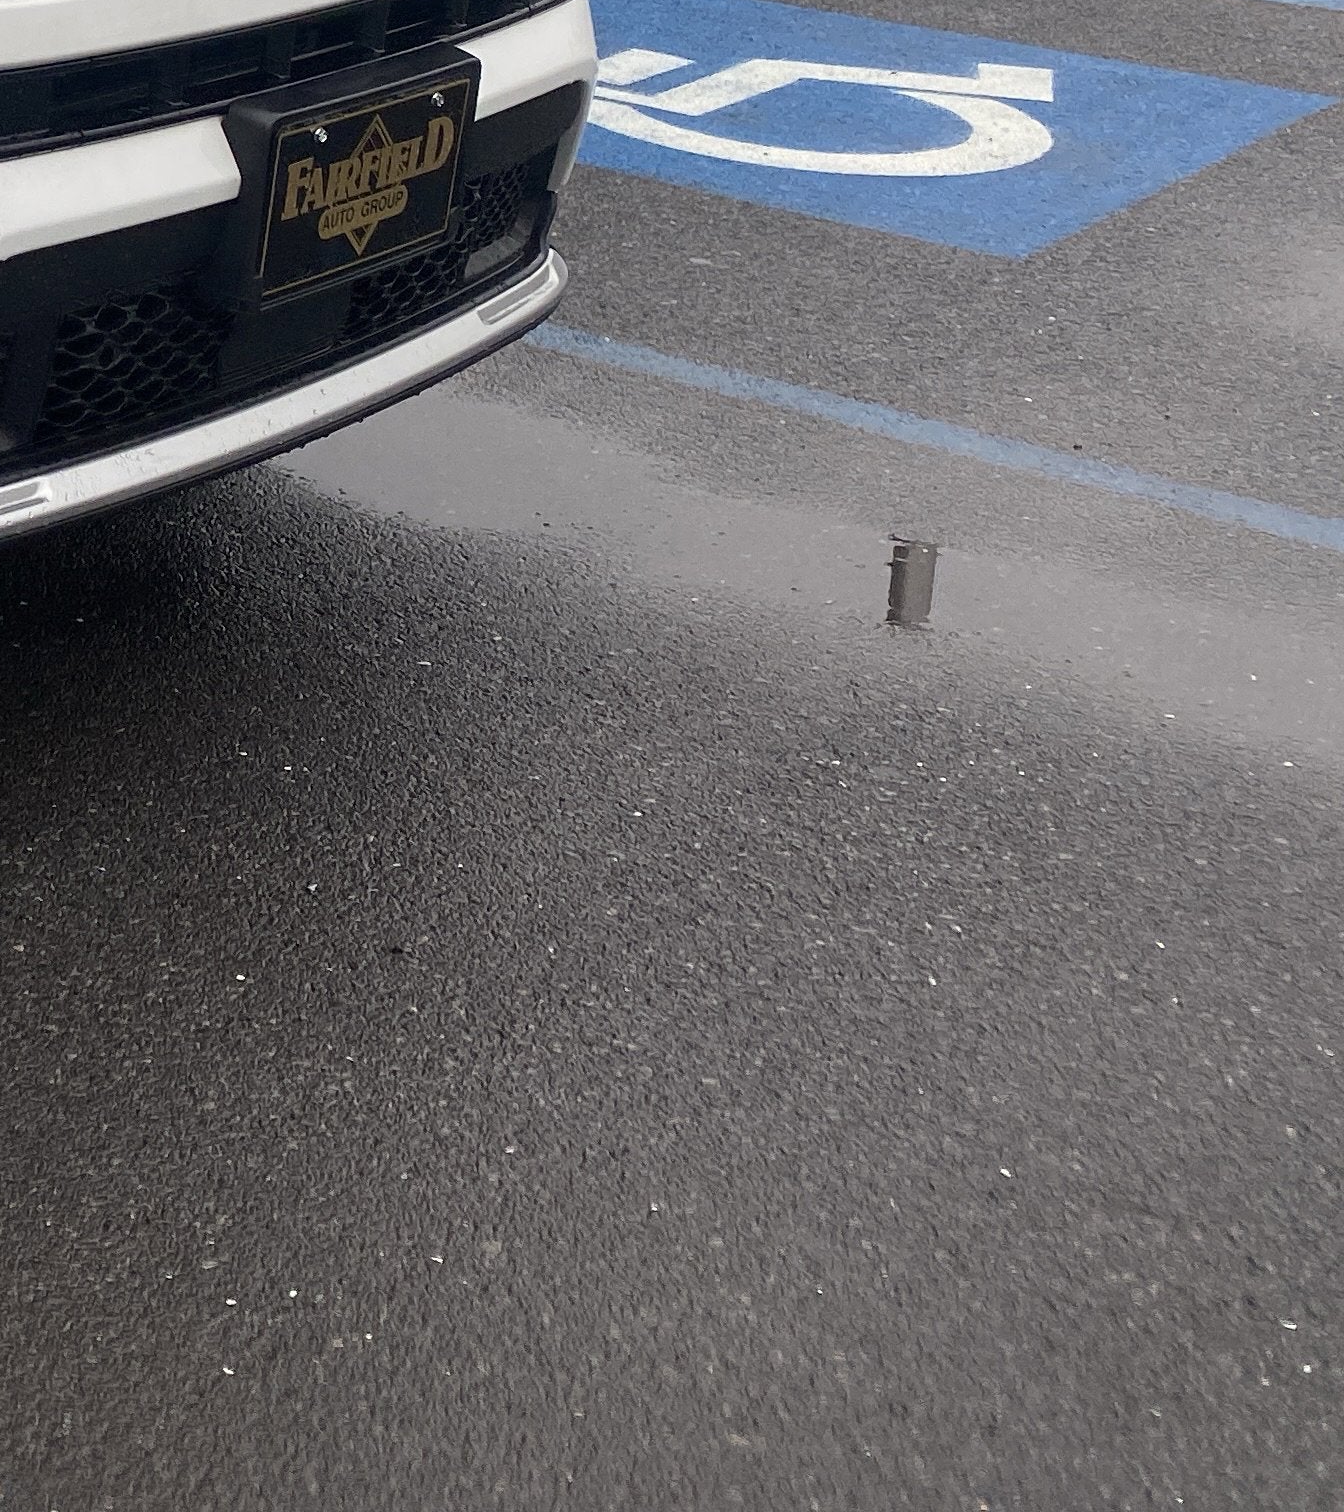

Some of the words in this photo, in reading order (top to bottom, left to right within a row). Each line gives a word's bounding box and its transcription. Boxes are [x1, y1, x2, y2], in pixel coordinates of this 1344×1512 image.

[280, 115, 455, 222] FAIRFIELD
[322, 206, 355, 233] AUTO
[361, 190, 405, 219] GROUP
